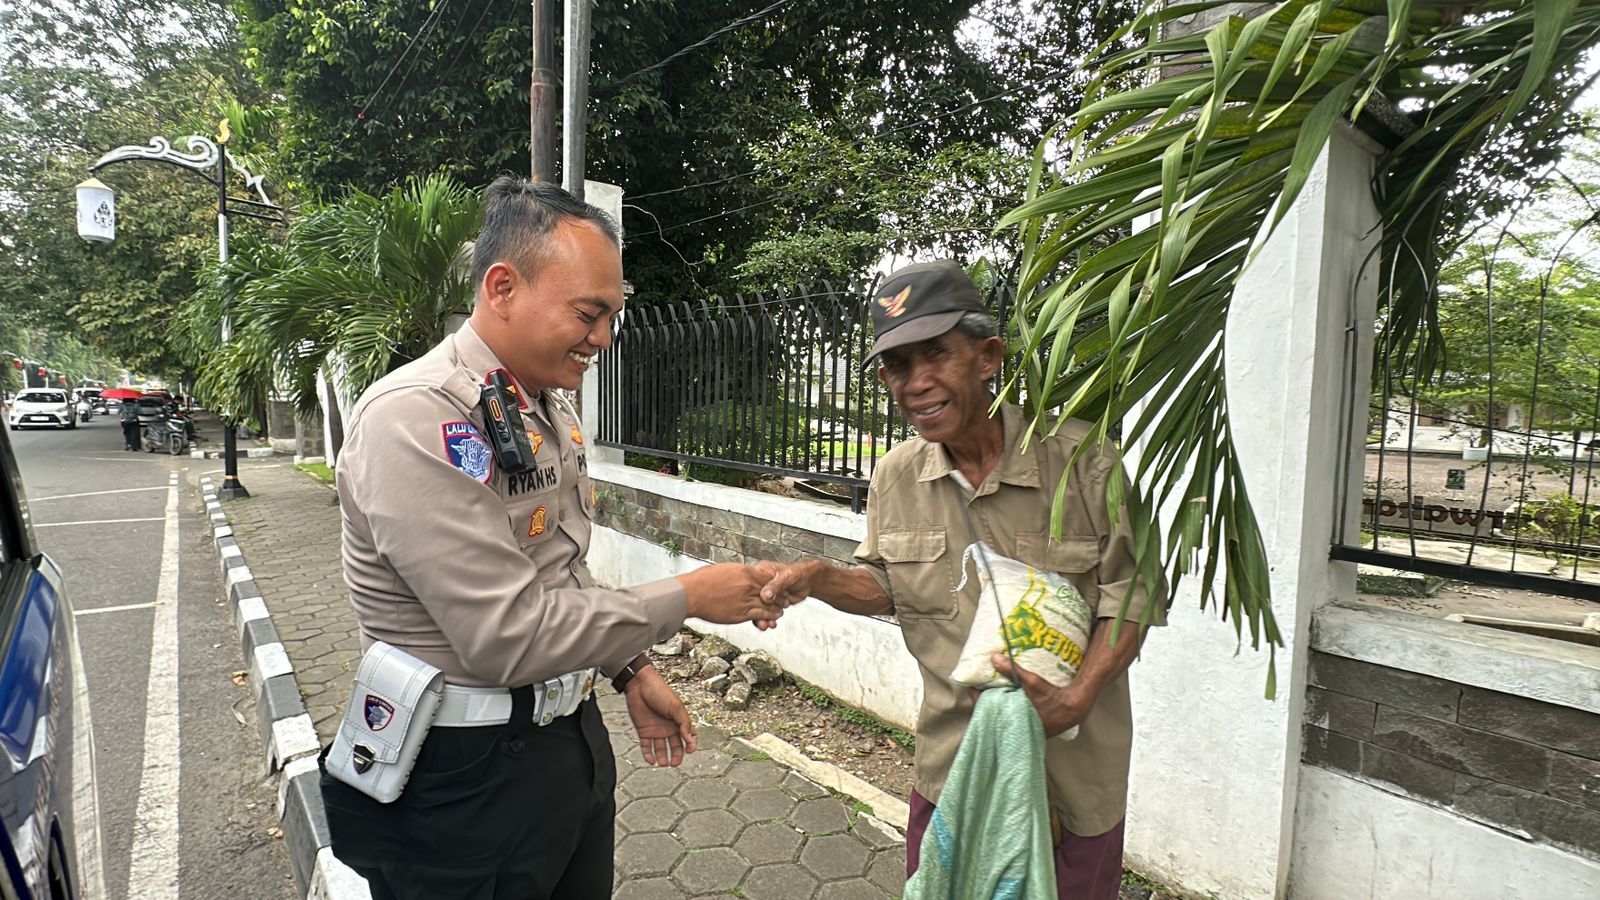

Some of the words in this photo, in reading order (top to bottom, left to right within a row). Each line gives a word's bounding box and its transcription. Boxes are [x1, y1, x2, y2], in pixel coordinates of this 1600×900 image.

[446, 424, 467, 435] LALU
[508, 470, 545, 496] RYAN
[545, 465, 556, 487] HS
